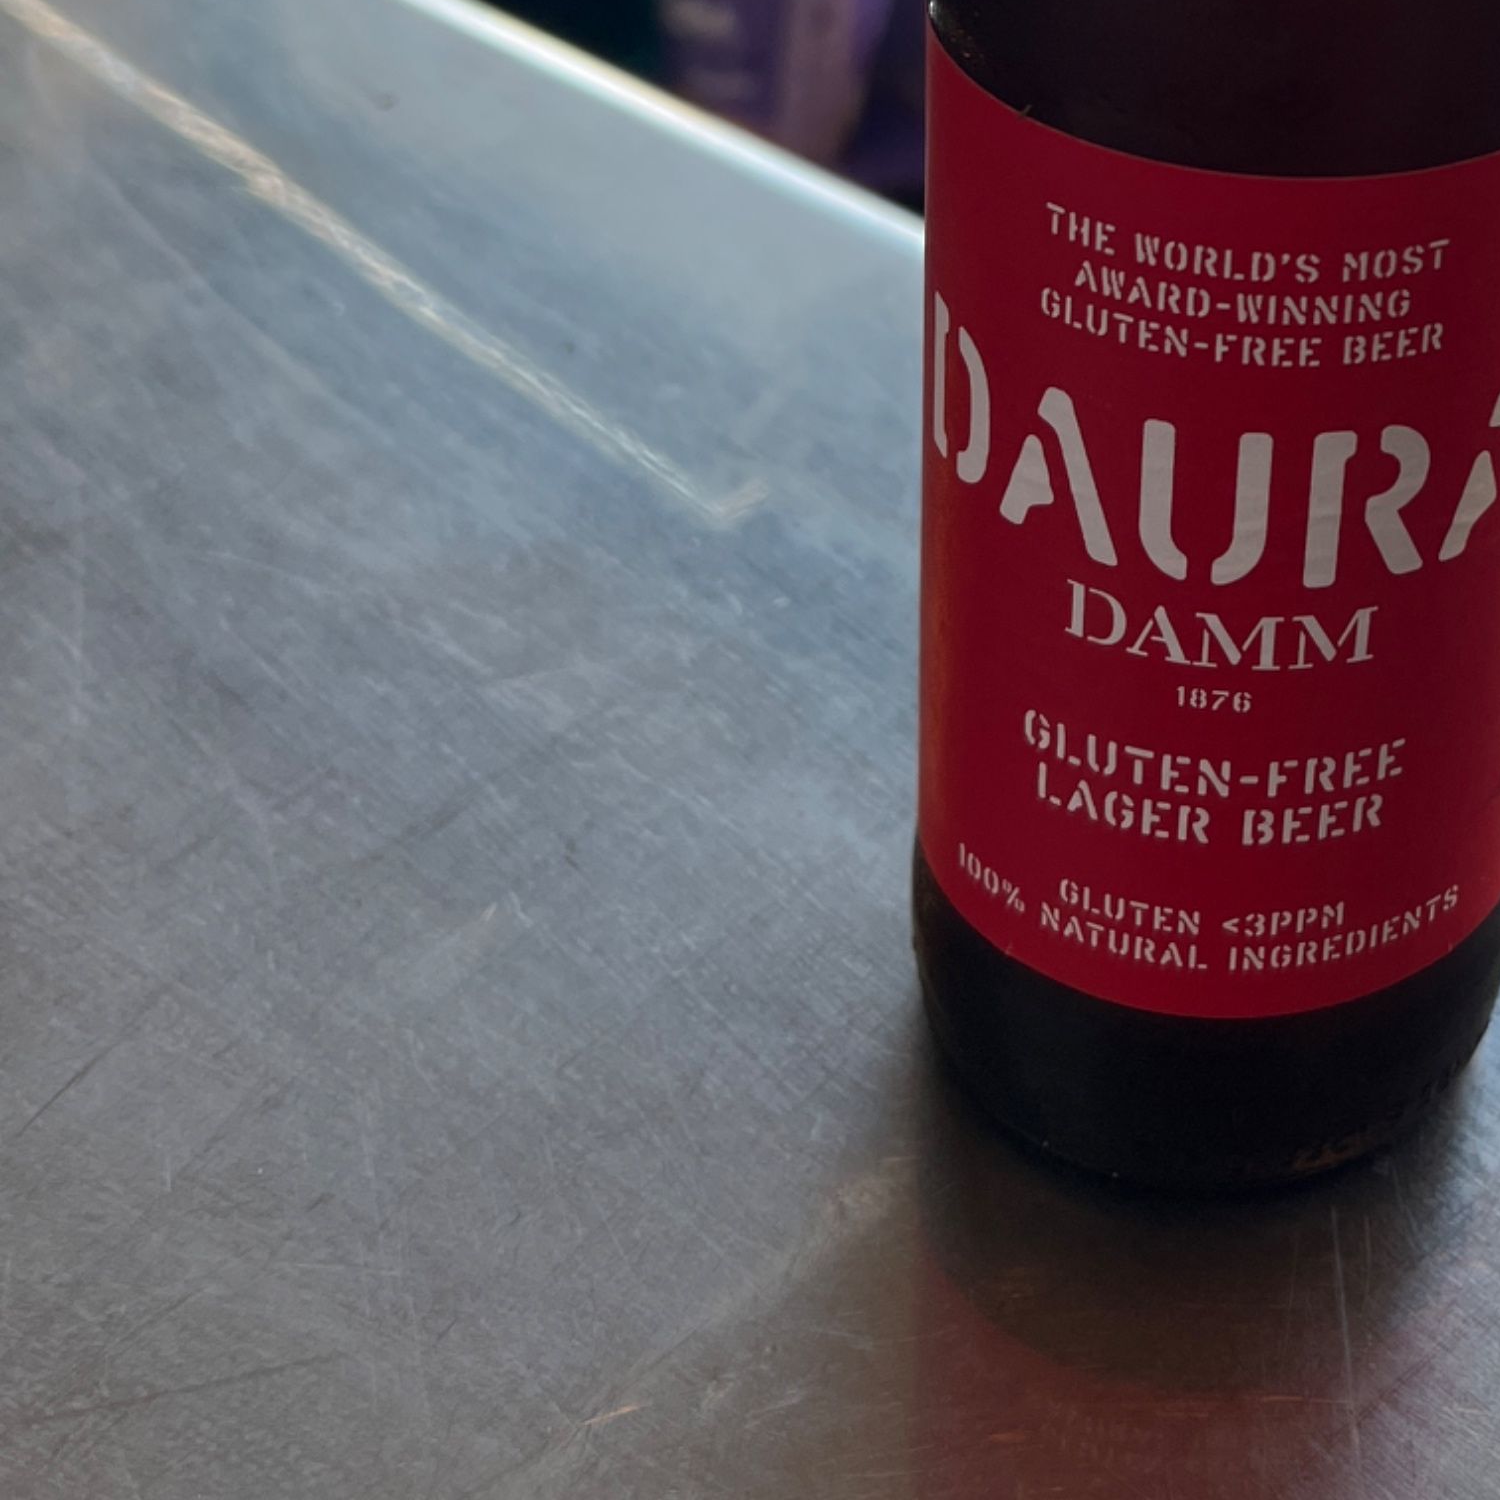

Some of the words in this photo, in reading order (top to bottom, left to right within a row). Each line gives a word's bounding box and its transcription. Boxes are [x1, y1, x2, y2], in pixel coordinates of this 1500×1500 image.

[1046, 202, 1116, 256] THE
[1134, 233, 1321, 284] WORLD'S
[1341, 239, 1450, 283] MOST
[1040, 287, 1322, 368] GLUTEN-FREE
[1342, 323, 1444, 366] BEER
[1074, 260, 1411, 326] AWARD-WINNING
[1064, 578, 1379, 671] DAMM
[1175, 685, 1253, 714] 1876
[1023, 708, 1406, 798] GLUTEN-FREE
[1037, 762, 1211, 845] LAGER
[1241, 794, 1384, 846] BEER
[957, 841, 1027, 913] 100%
[1040, 902, 1208, 970] NATURAL
[1228, 884, 1460, 973] INGREDIENTS
[1058, 877, 1201, 935] GLUTEN
[1221, 902, 1346, 938] <3PPM
